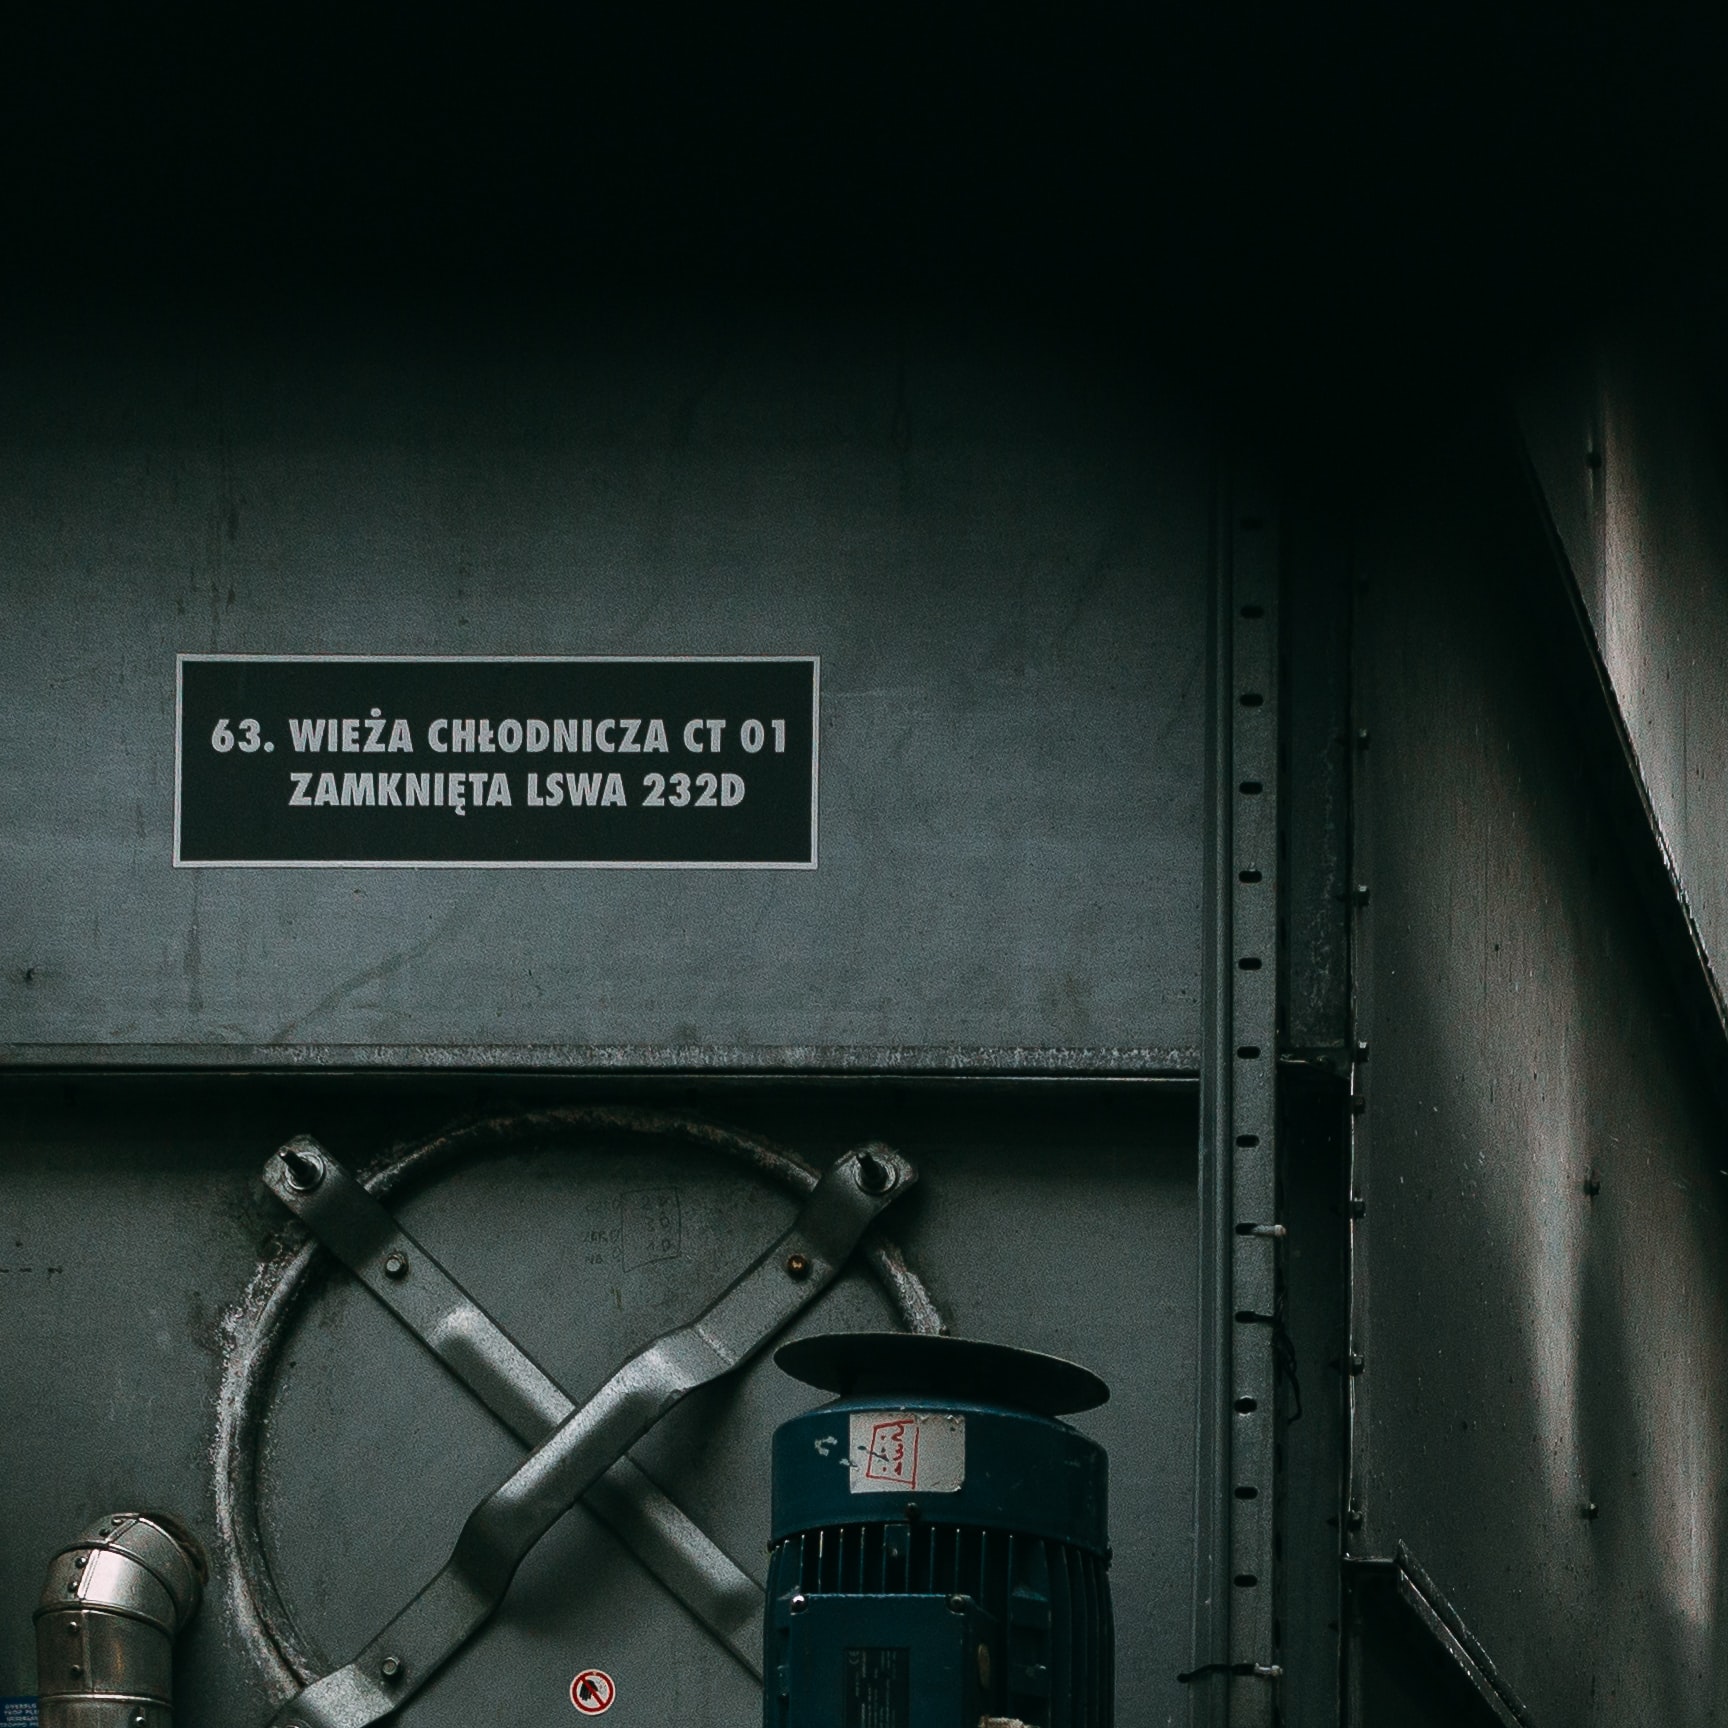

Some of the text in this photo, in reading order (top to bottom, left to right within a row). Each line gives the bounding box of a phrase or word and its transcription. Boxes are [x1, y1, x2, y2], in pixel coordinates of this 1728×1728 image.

[211, 707, 786, 754] 63. WIEŻA CHŁODNICZA CT 01
[288, 772, 746, 817] ZAMKNIĘTA LSWA 232D
